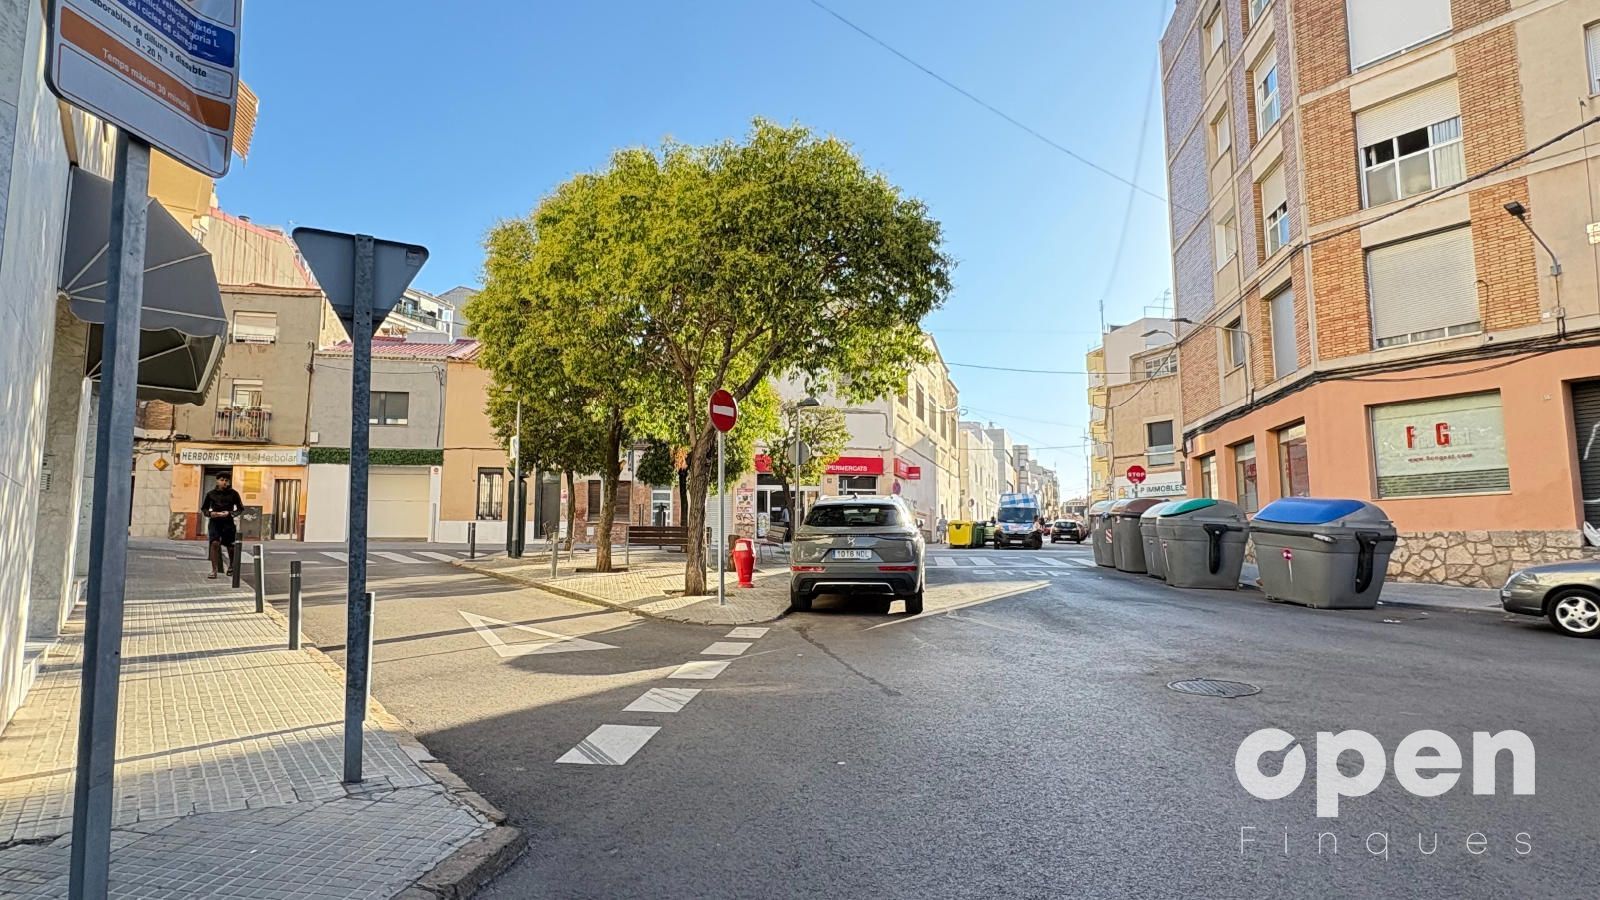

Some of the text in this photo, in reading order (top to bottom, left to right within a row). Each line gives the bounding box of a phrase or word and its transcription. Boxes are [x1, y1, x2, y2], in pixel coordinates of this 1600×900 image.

[91, 0, 207, 77] aborables de dilluns a dissabte
[167, 14, 176, 25] de
[213, 39, 220, 48] L
[135, 37, 141, 48] 8
[146, 45, 156, 58] 20
[157, 51, 163, 62] h
[102, 47, 130, 73] Temps
[156, 83, 167, 96] 30
[167, 91, 191, 112] minuts
[182, 451, 240, 461] HERBORISTERIA
[1146, 484, 1185, 493] IMMOBLES
